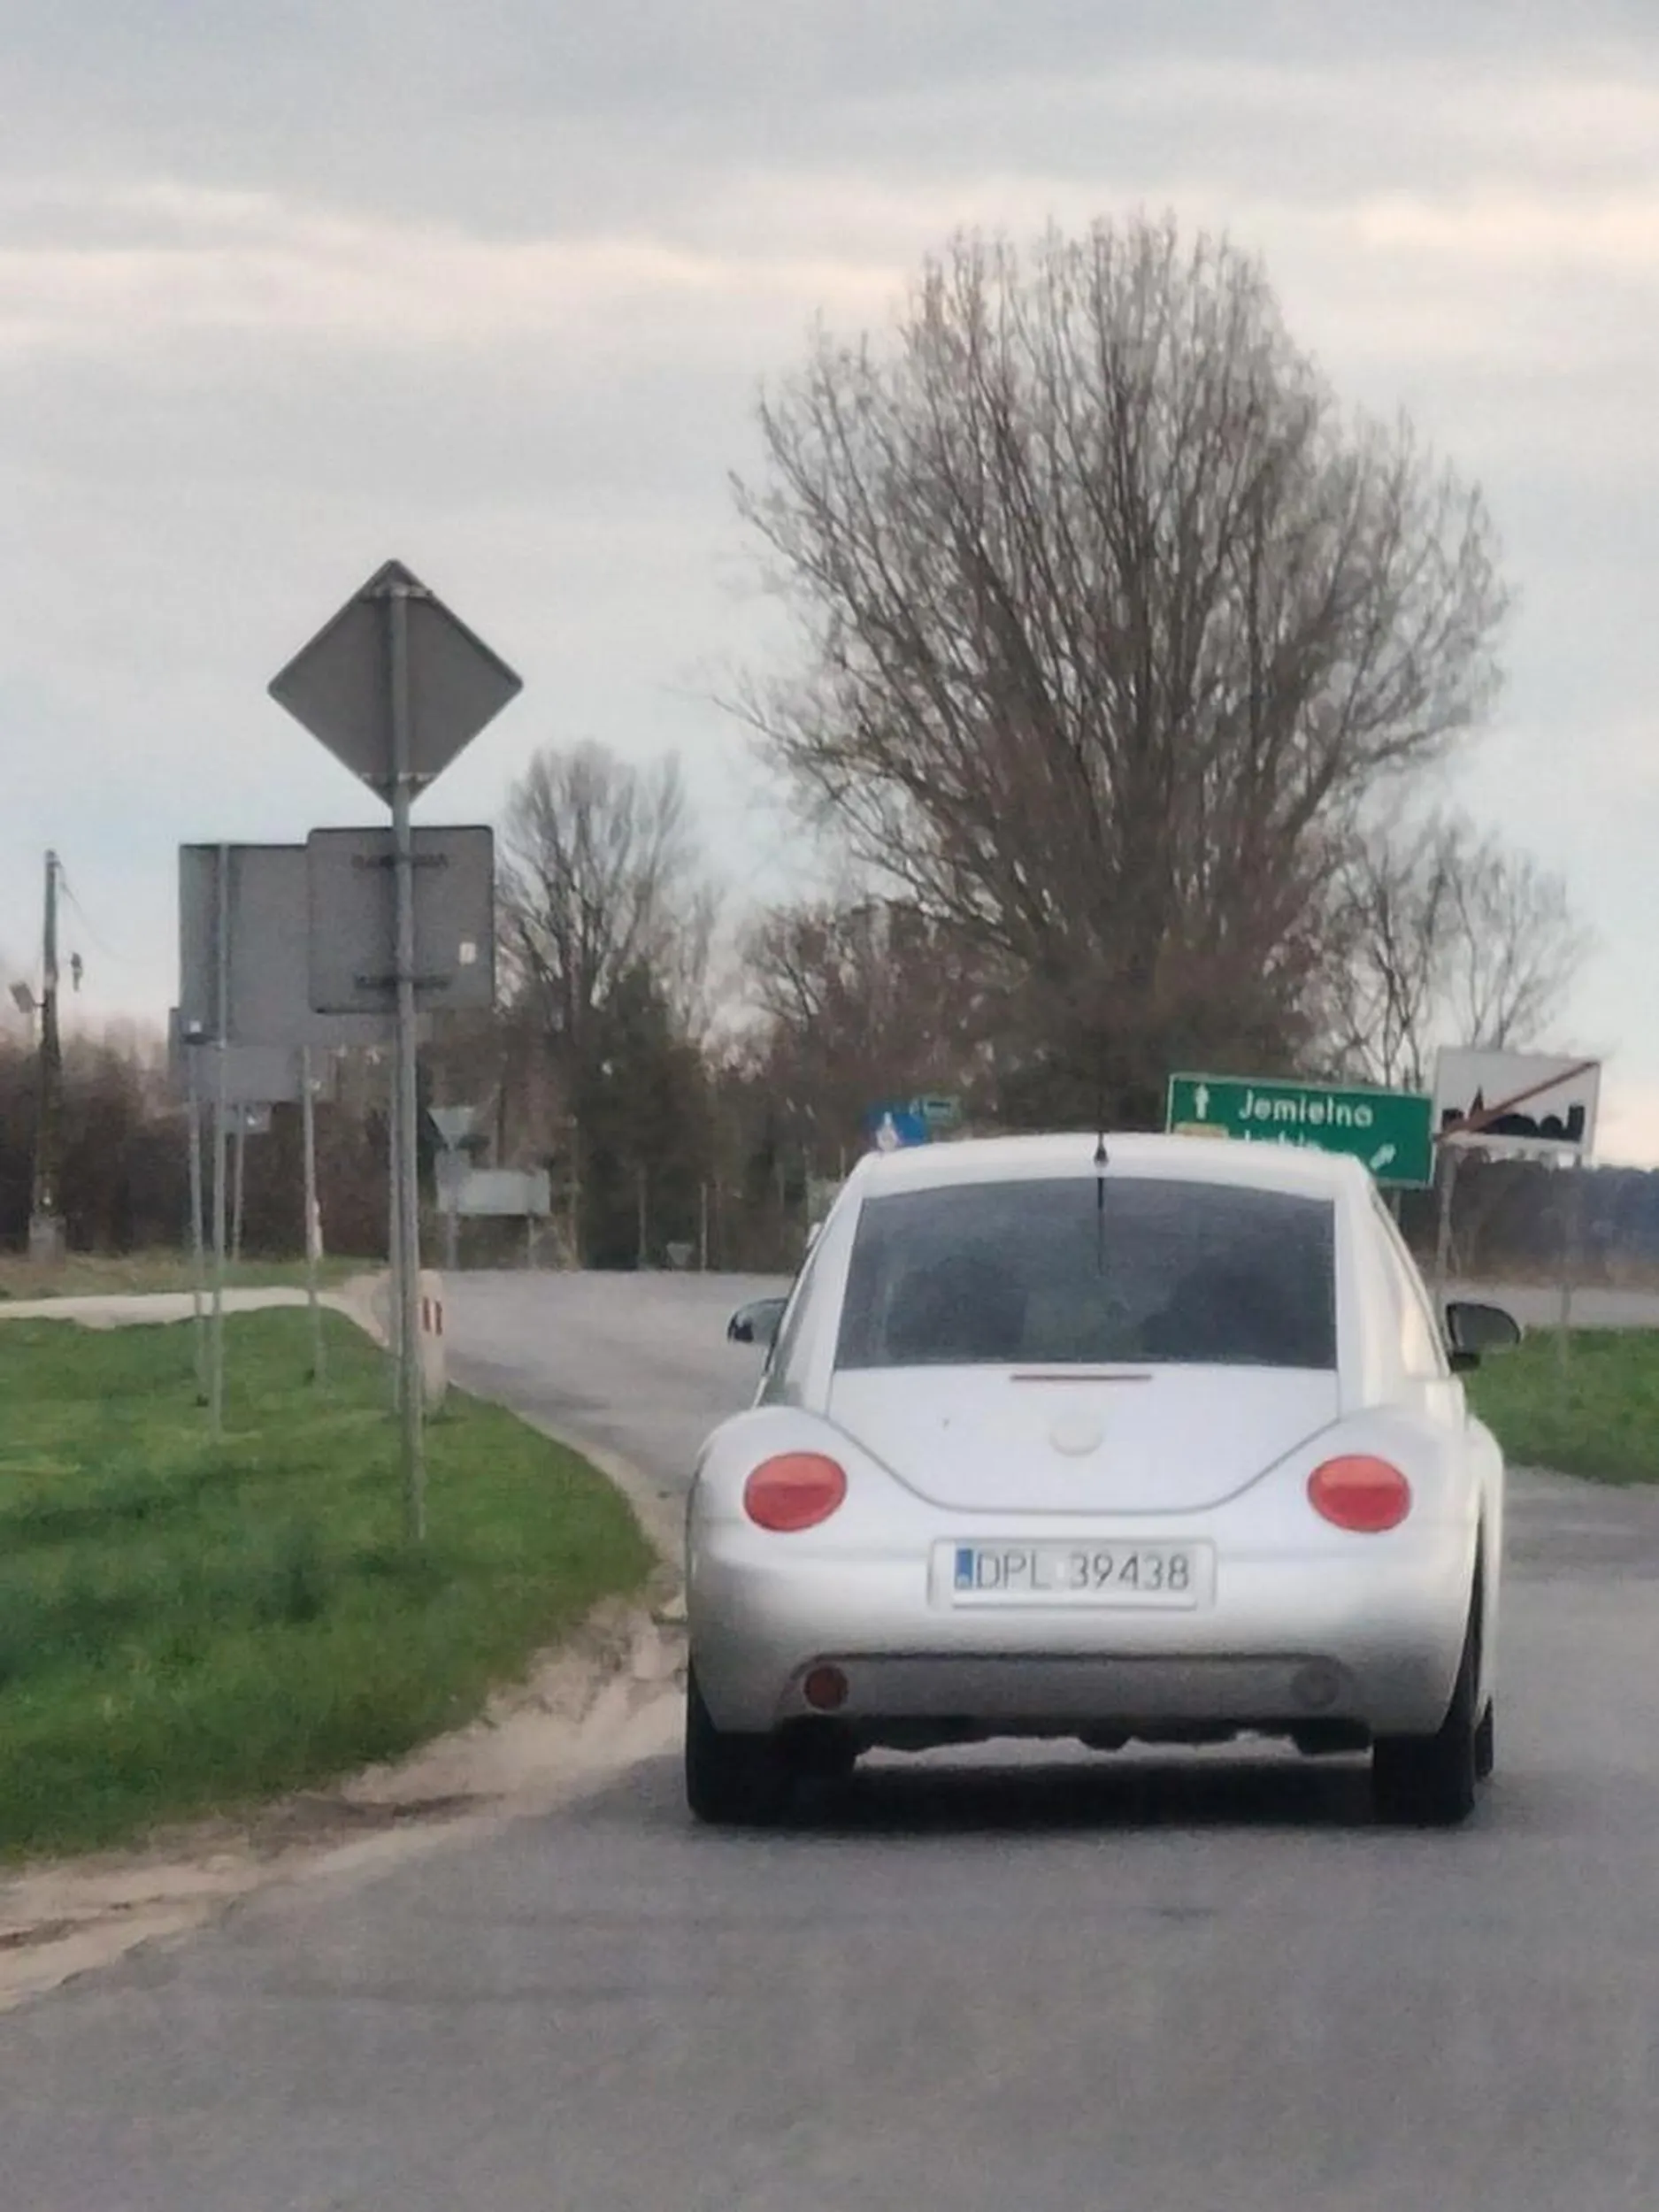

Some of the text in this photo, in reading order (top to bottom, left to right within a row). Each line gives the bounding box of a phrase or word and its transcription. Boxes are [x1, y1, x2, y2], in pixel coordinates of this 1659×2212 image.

[1239, 1088, 1372, 1127] Jemielna
[976, 1550, 1189, 1591] DPL 39438
